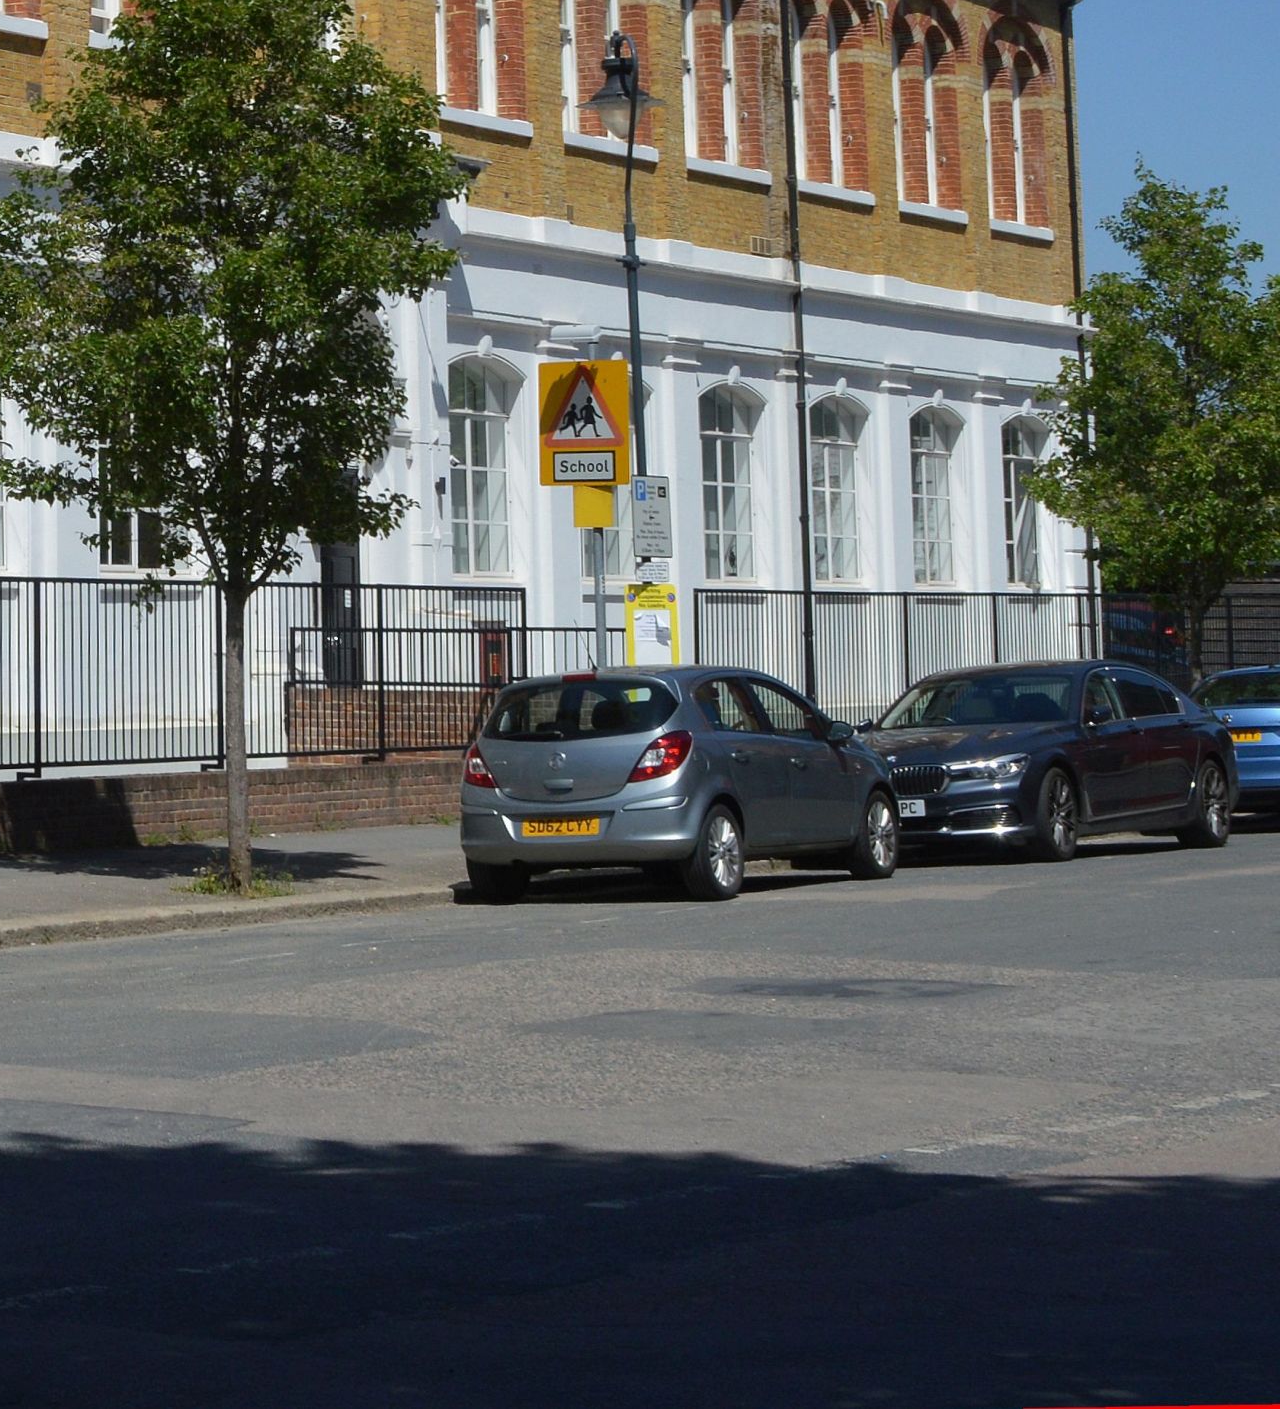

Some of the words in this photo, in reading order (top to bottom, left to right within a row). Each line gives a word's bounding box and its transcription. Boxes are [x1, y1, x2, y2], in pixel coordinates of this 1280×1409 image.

[559, 460, 609, 473] School
[528, 818, 562, 833] SD62
[567, 817, 592, 832] CYY
